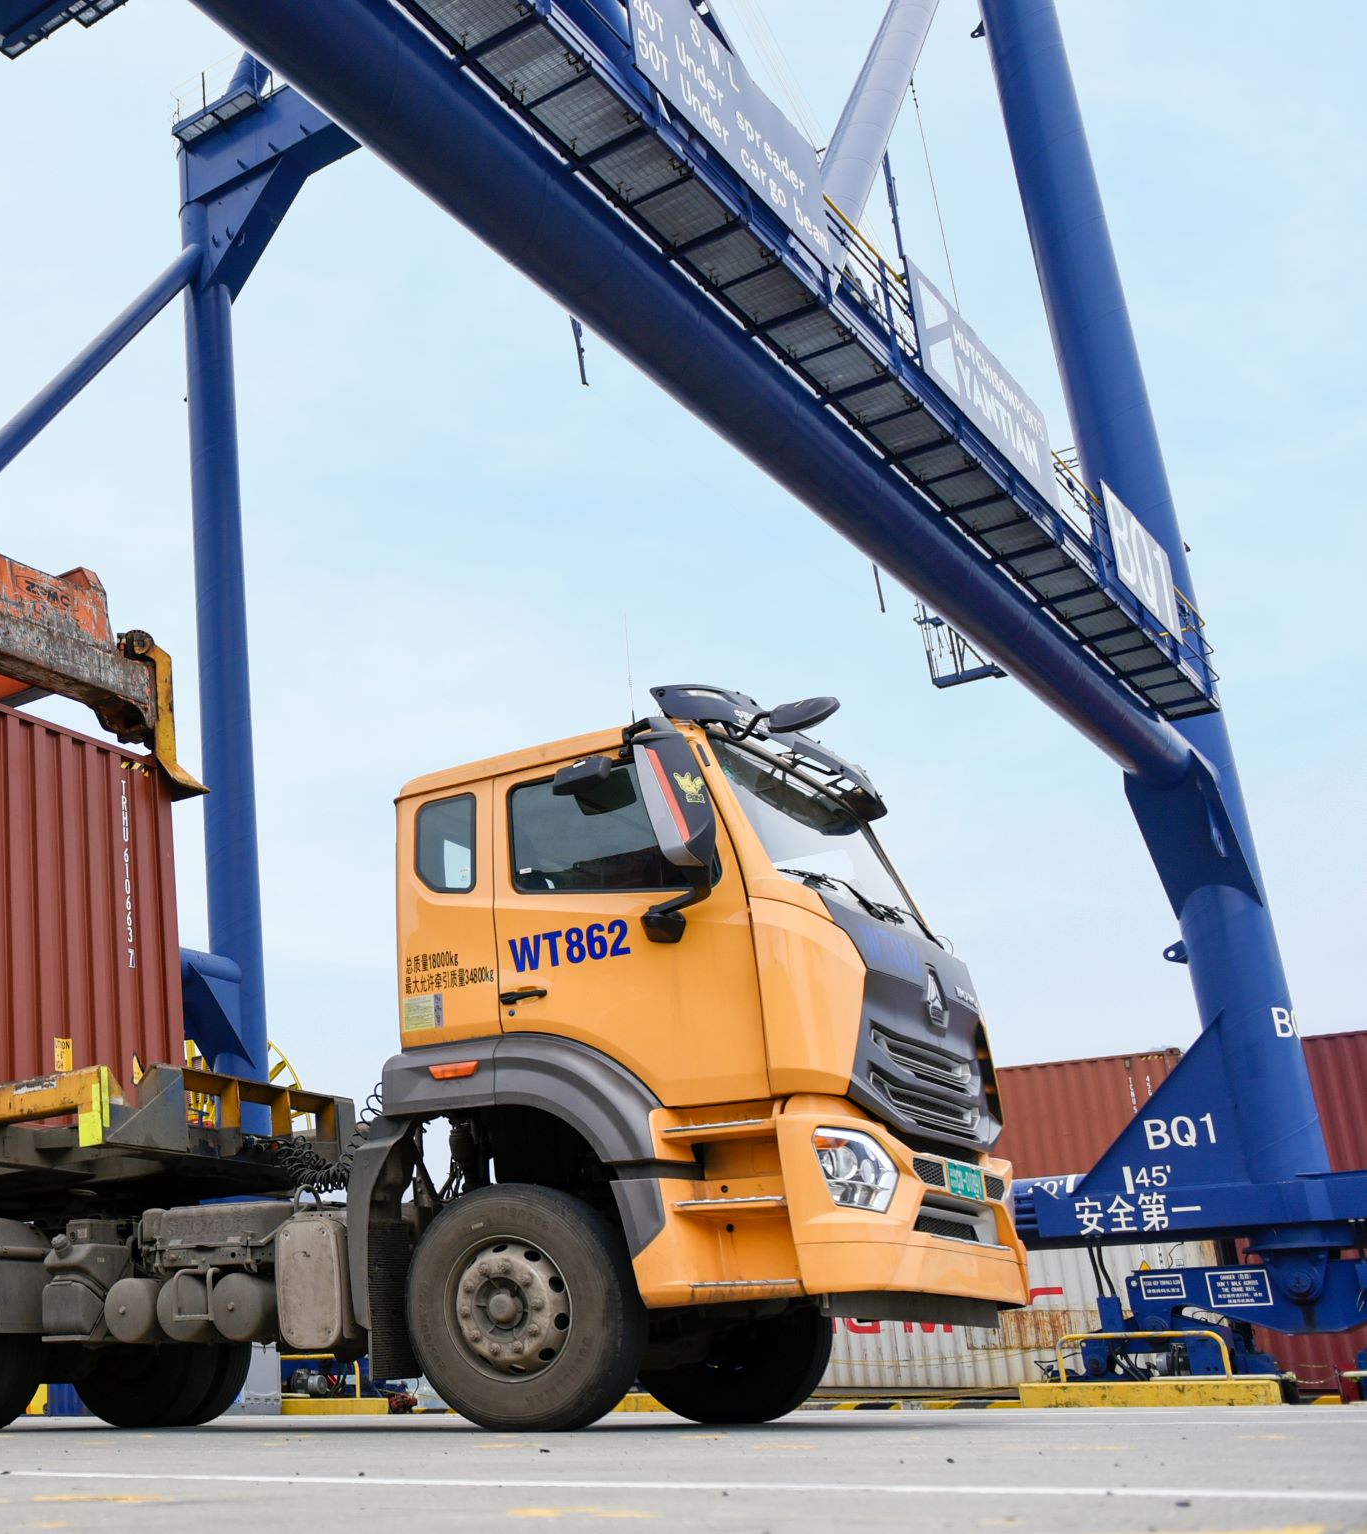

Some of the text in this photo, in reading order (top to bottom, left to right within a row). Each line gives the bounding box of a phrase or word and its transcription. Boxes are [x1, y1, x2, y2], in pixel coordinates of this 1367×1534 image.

[637, 27, 830, 256] 50T Under cargo beam
[675, 34, 724, 107] Under
[736, 110, 806, 196] spreader
[955, 355, 1042, 476] YANTIAN
[1111, 505, 1180, 641] BQ1
[121, 779, 130, 843] TRHU
[123, 847, 133, 944] 610663
[508, 918, 632, 973] WT862
[1143, 1112, 1217, 1151] BQ1
[1074, 1192, 1202, 1236] 安全第一
[1135, 1165, 1171, 1188] 45'
